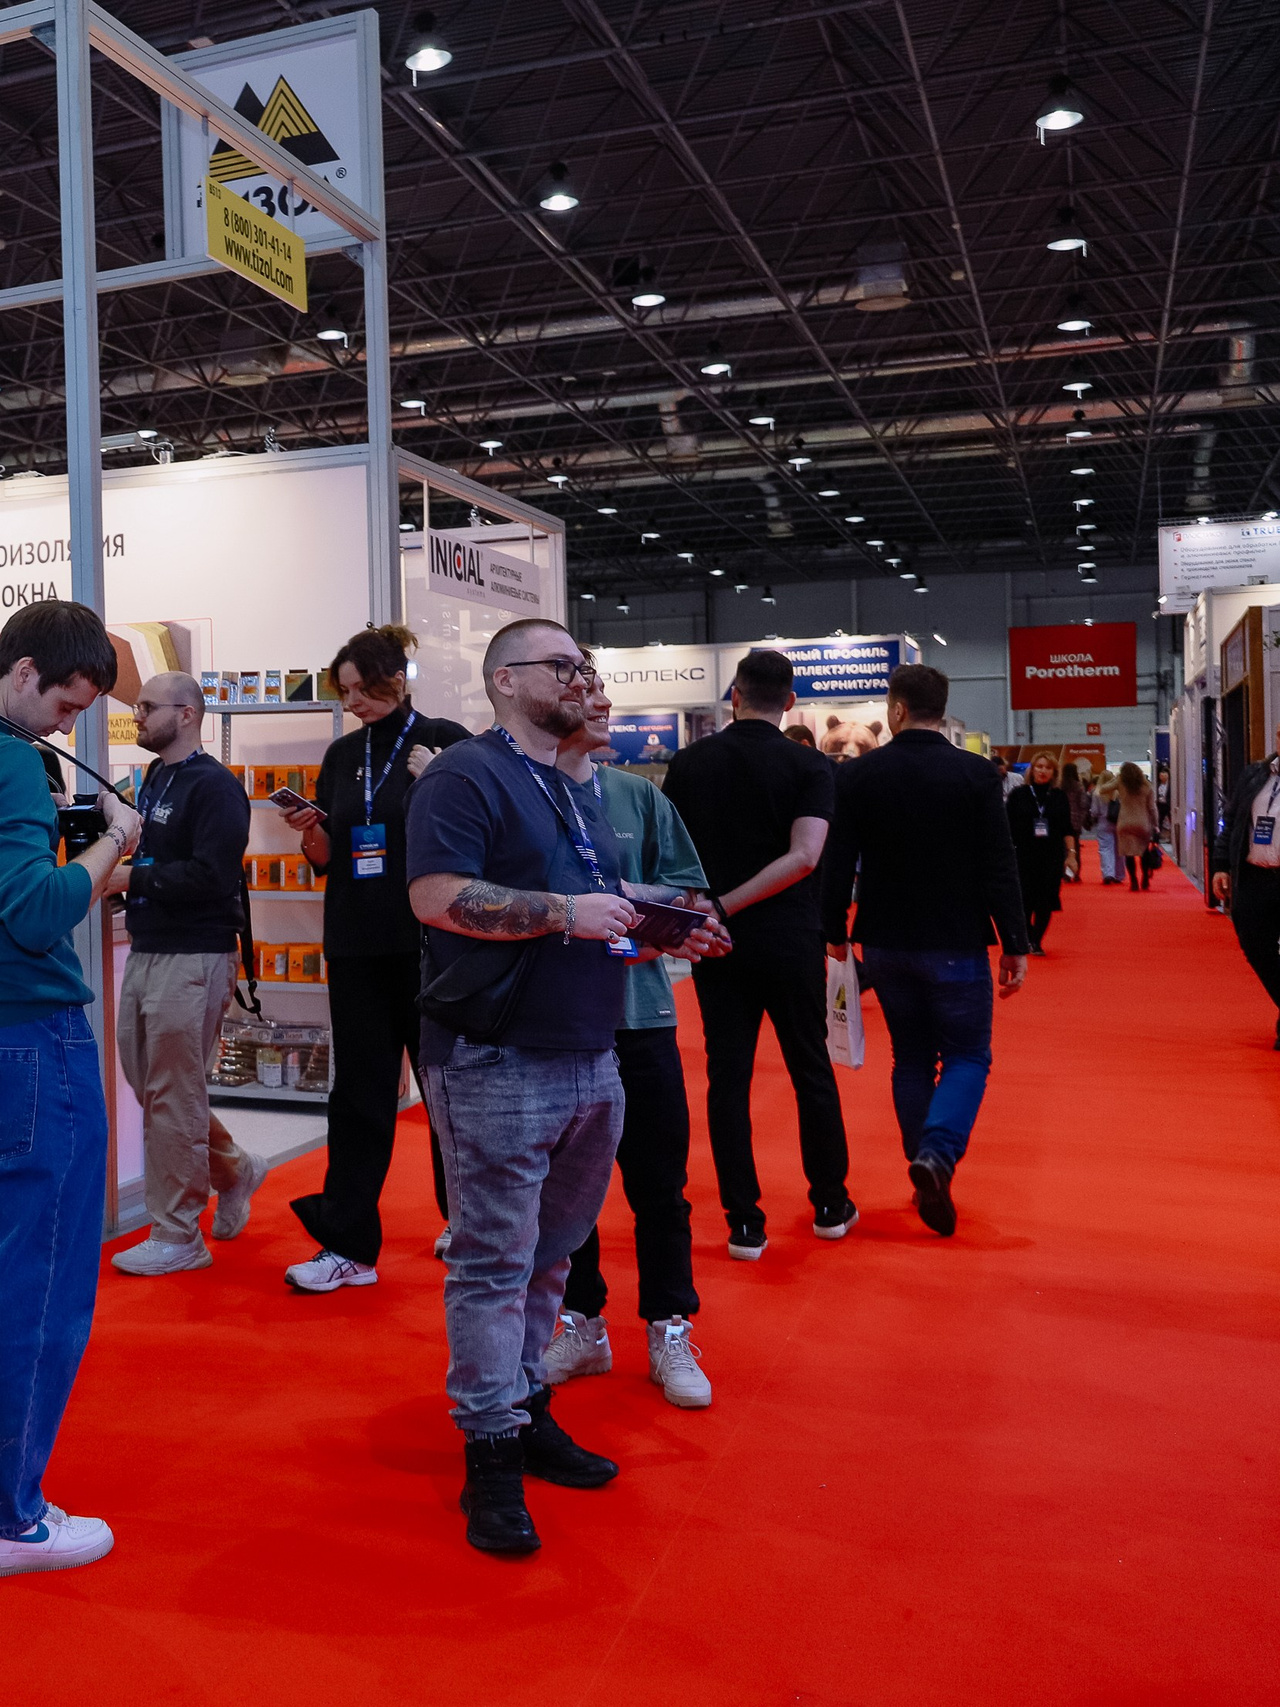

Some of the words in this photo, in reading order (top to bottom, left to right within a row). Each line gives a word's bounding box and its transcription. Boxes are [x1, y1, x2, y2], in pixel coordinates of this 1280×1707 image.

[223, 207, 230, 227] 8
[230, 211, 252, 243] (800)
[254, 229, 293, 264] 301-41-14
[224, 235, 294, 295] www.tizol.com
[429, 535, 485, 587] INICIAL
[823, 647, 889, 660] ПРОФИЛЬ
[1049, 653, 1094, 663] ШКОЛА
[1025, 664, 1120, 679] Porotherm
[812, 678, 890, 691] ФУРНИТУРА
